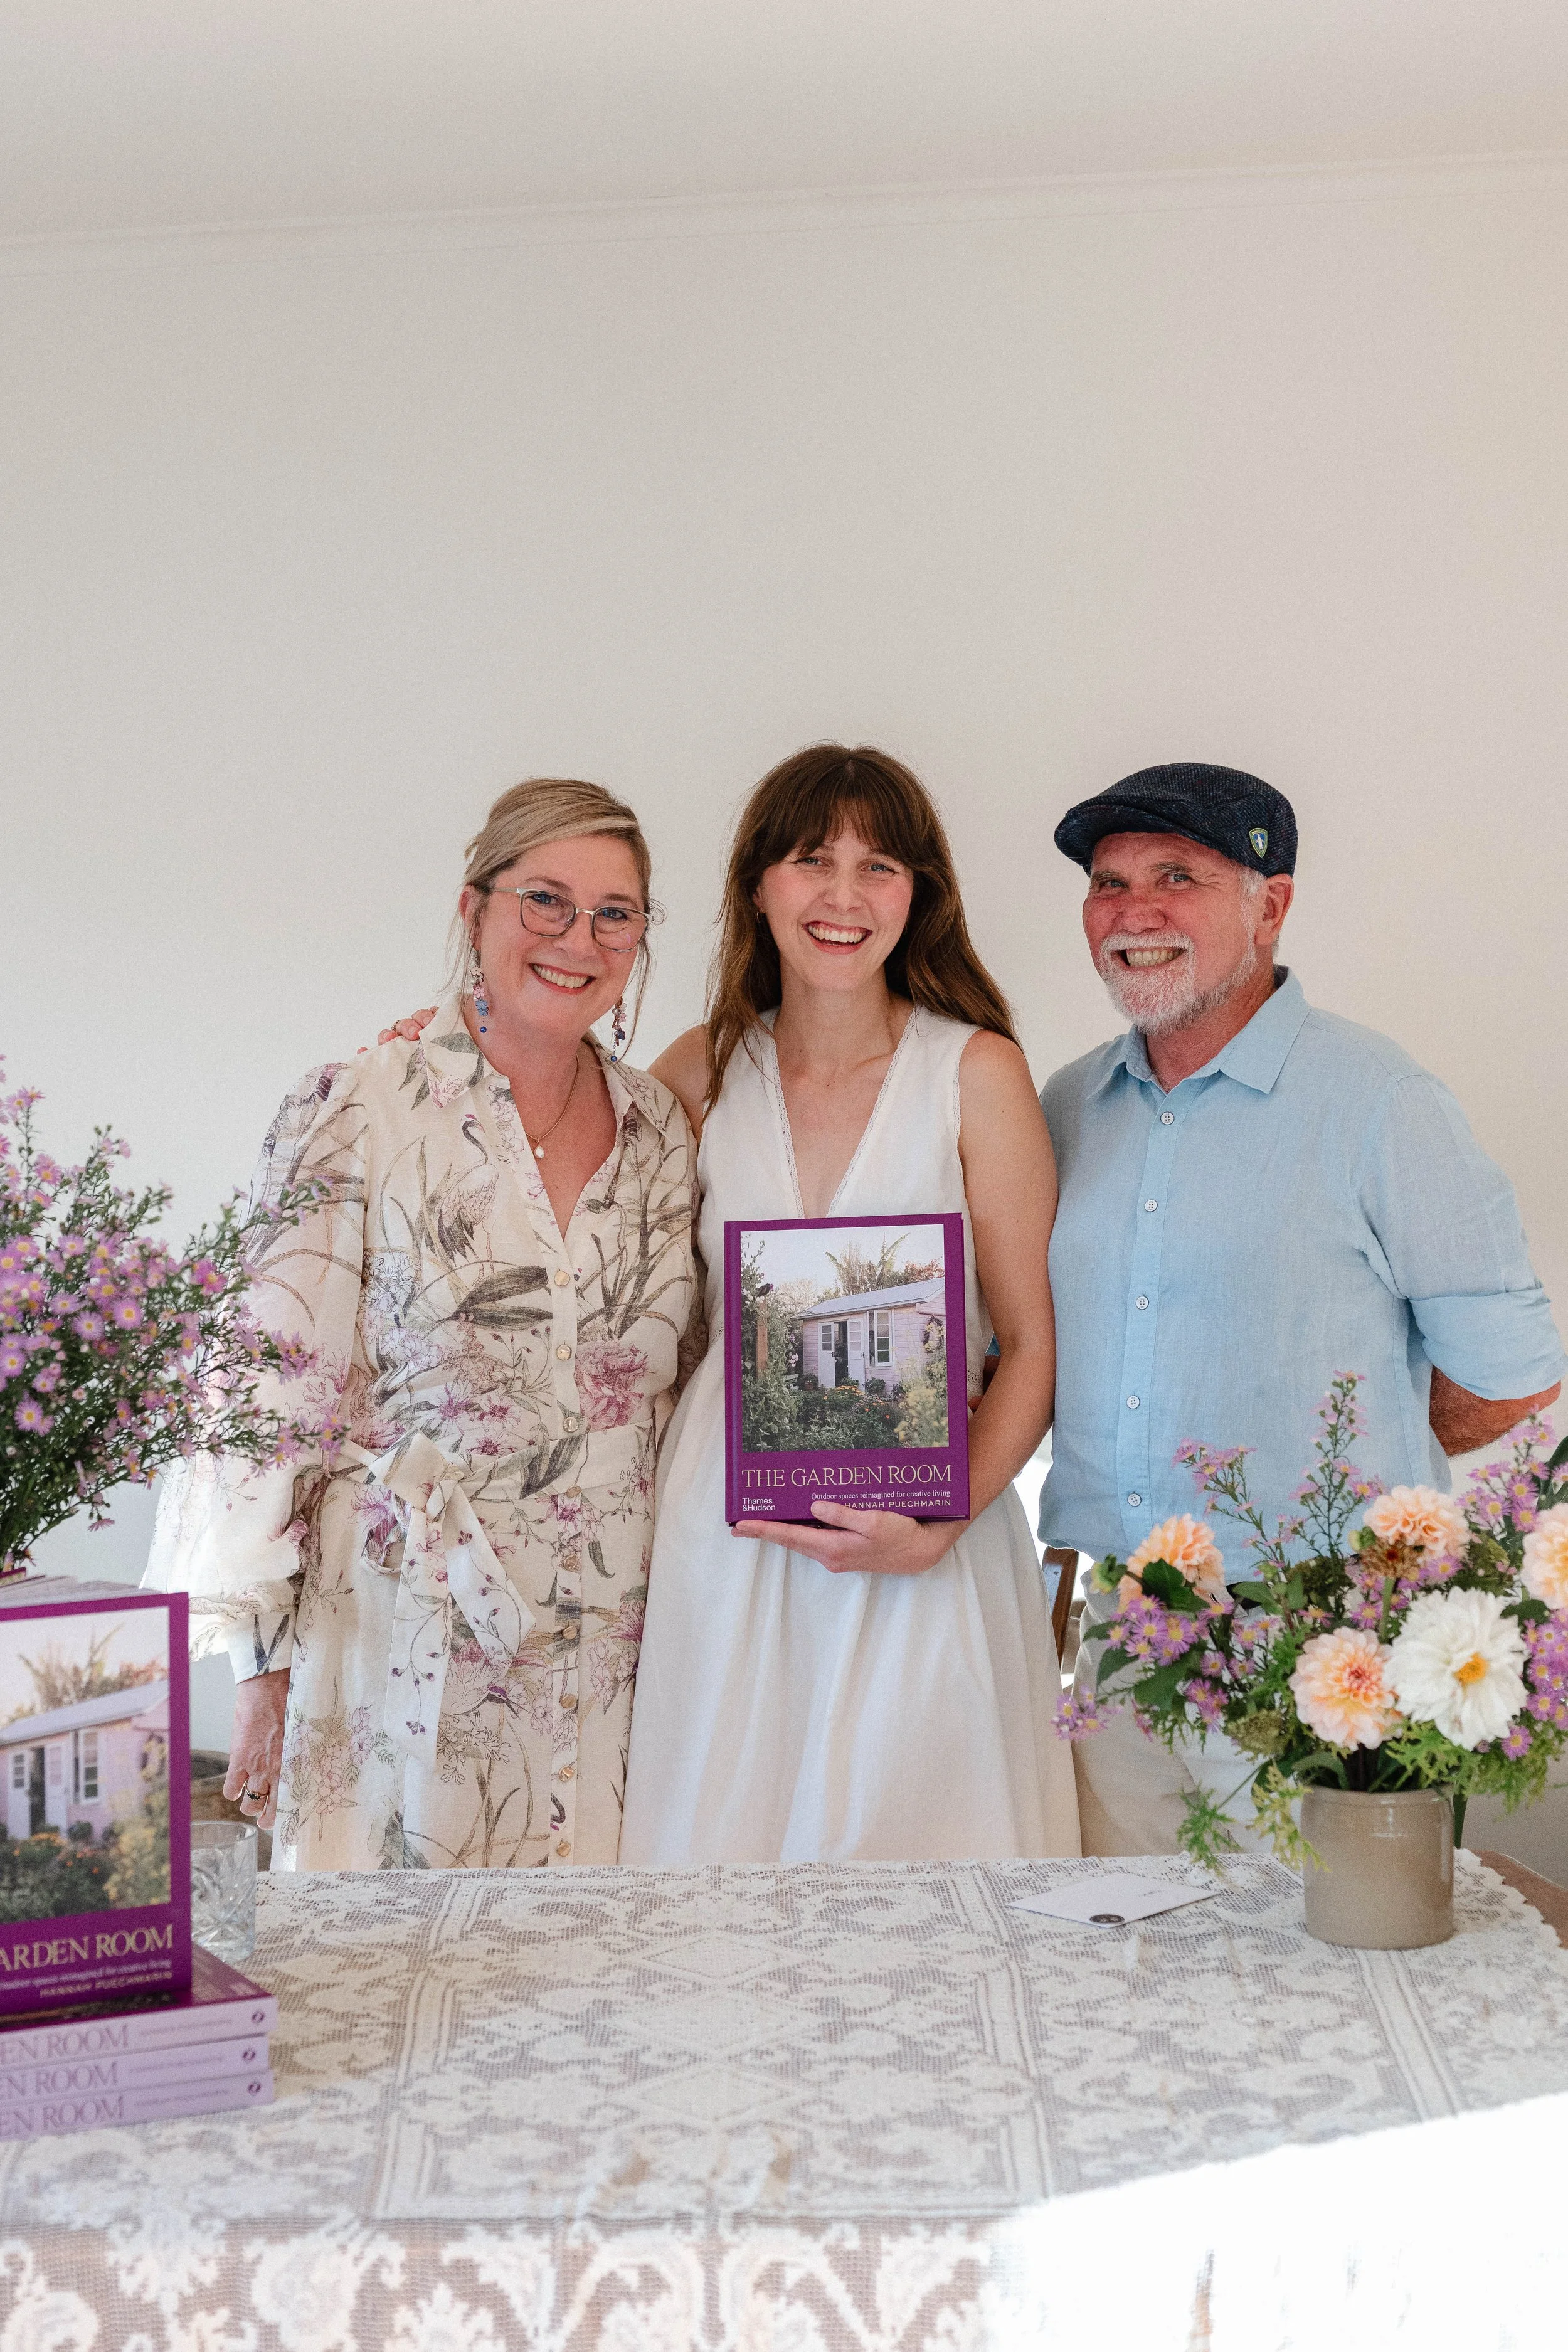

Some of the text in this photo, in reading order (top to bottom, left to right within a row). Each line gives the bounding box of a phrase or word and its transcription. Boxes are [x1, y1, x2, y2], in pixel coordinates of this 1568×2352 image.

[742, 1464, 952, 1488] THE GARDEN ROOM
[838, 1492, 859, 1500] spaces
[860, 1491, 894, 1500] reimagined
[933, 1490, 950, 1498] living
[889, 1499, 951, 1508] PUECHMARIN
[95, 1924, 173, 1959] ROOM
[47, 2023, 129, 2058] ROOM
[35, 2061, 118, 2095] ROOM
[43, 2095, 125, 2131] ROOM
